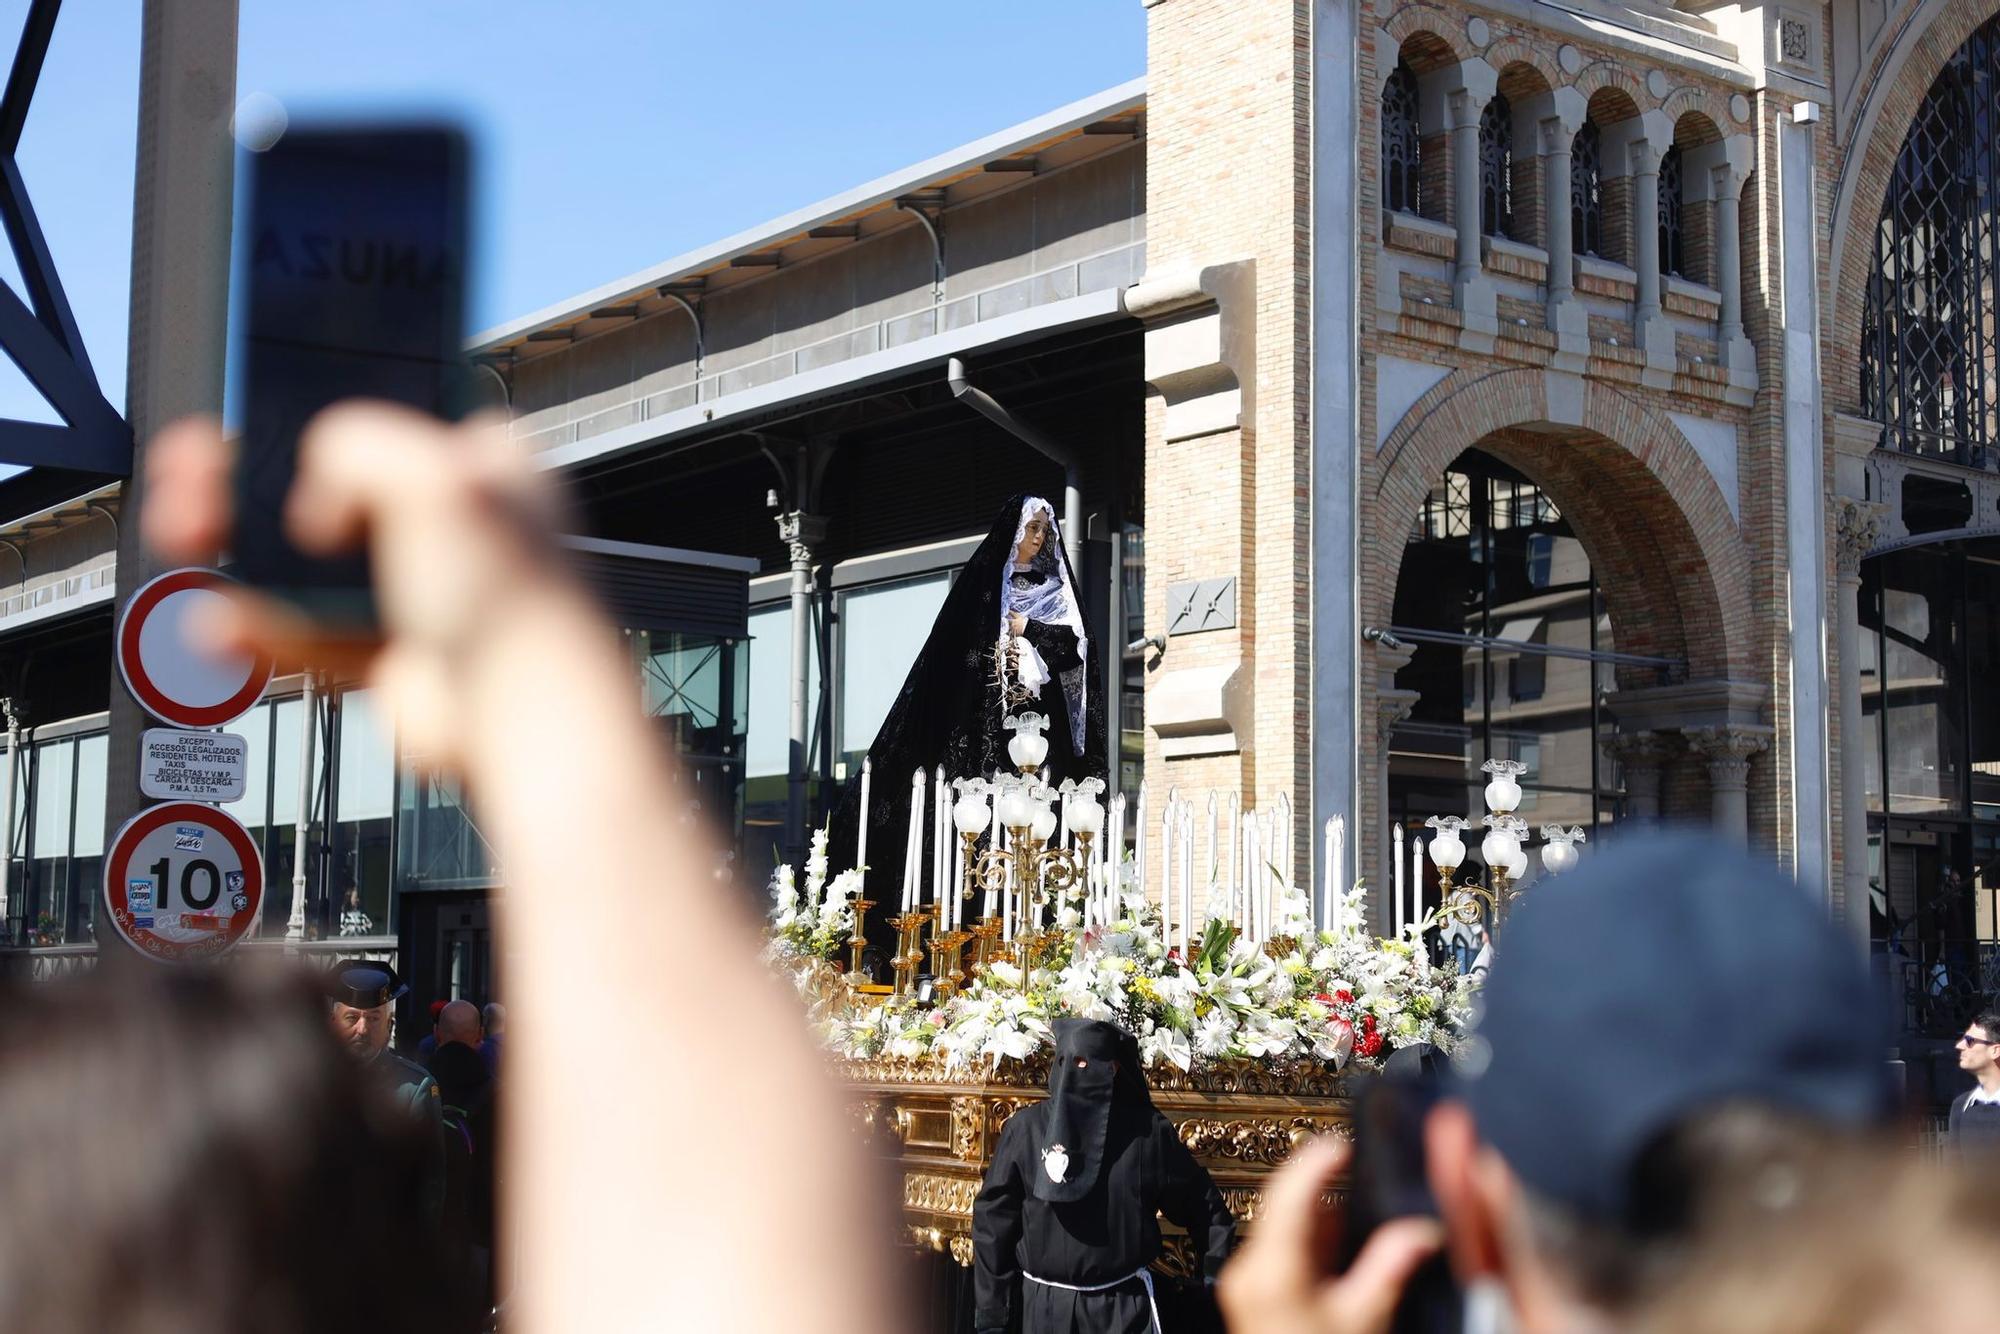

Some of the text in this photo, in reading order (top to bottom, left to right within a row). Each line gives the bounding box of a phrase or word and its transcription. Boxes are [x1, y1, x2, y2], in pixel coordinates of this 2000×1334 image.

[179, 737, 215, 746] EXCEPTO
[149, 744, 242, 755] ACCESOS LEGALIZADOS,
[165, 760, 186, 768] TAXIS
[202, 756, 238, 764] HOTELES,
[158, 768, 202, 777] BICICLETAS
[155, 775, 182, 784] CARGA
[191, 777, 233, 786] DESCARGA
[150, 858, 220, 910] 10
